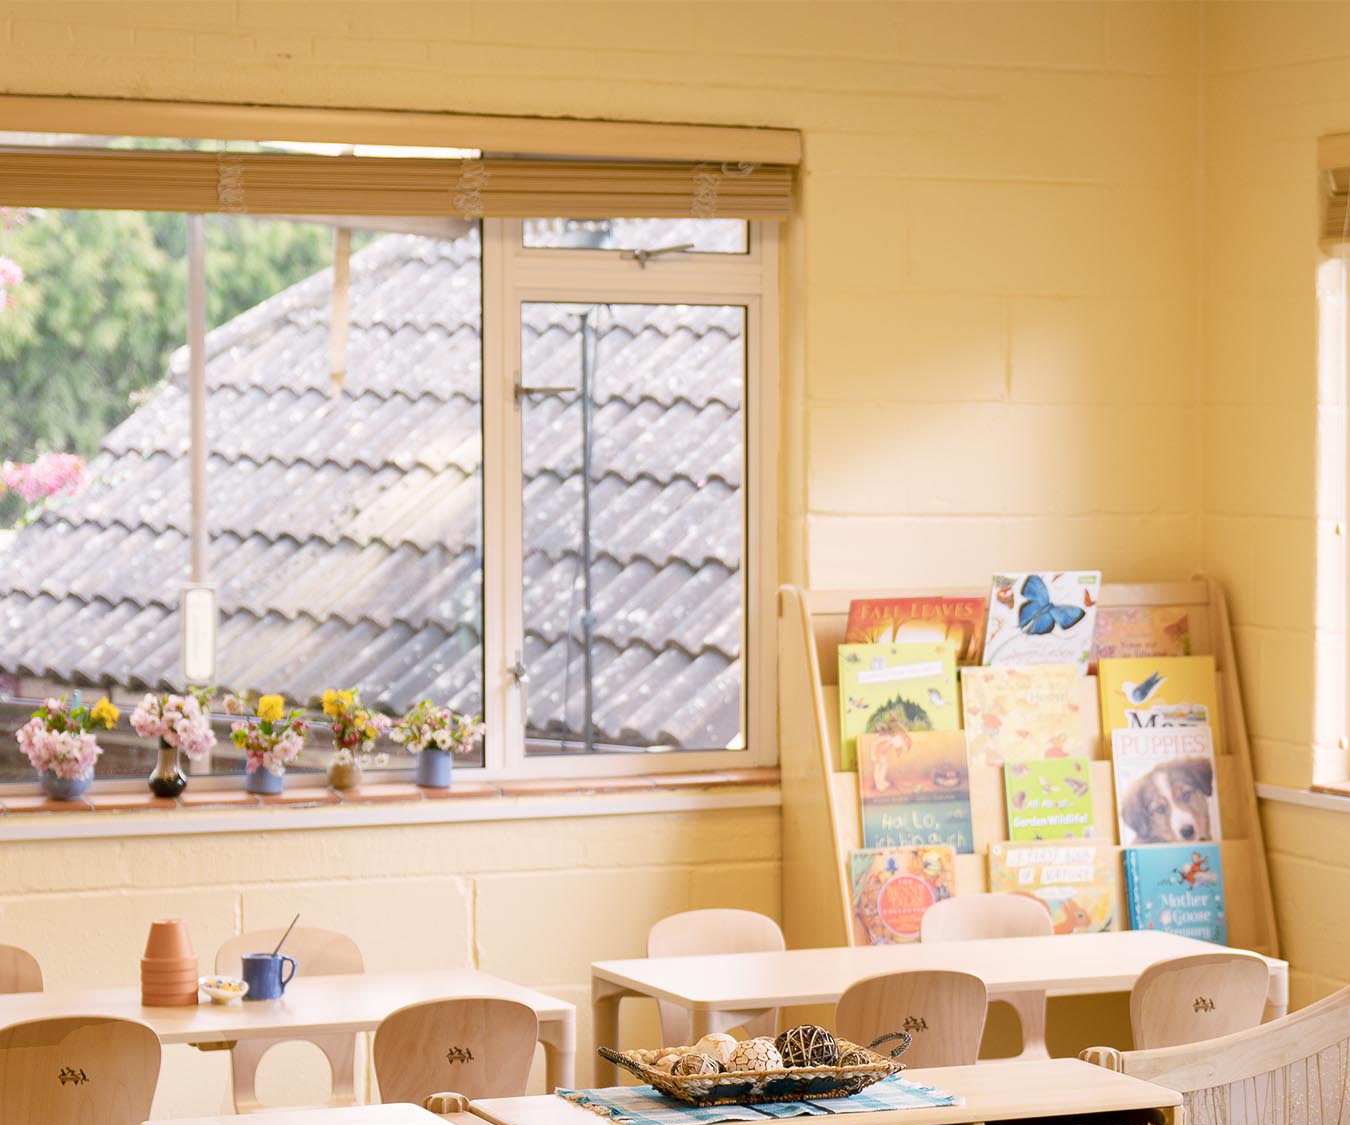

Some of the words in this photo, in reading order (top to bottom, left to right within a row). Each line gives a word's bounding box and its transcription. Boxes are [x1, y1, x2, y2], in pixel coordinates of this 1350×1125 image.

[861, 604, 900, 619] FALL
[911, 602, 974, 618] LEAVES
[1119, 735, 1206, 756] PUPPIES
[1160, 891, 1209, 908] Mother
[1172, 909, 1212, 925] Goose
